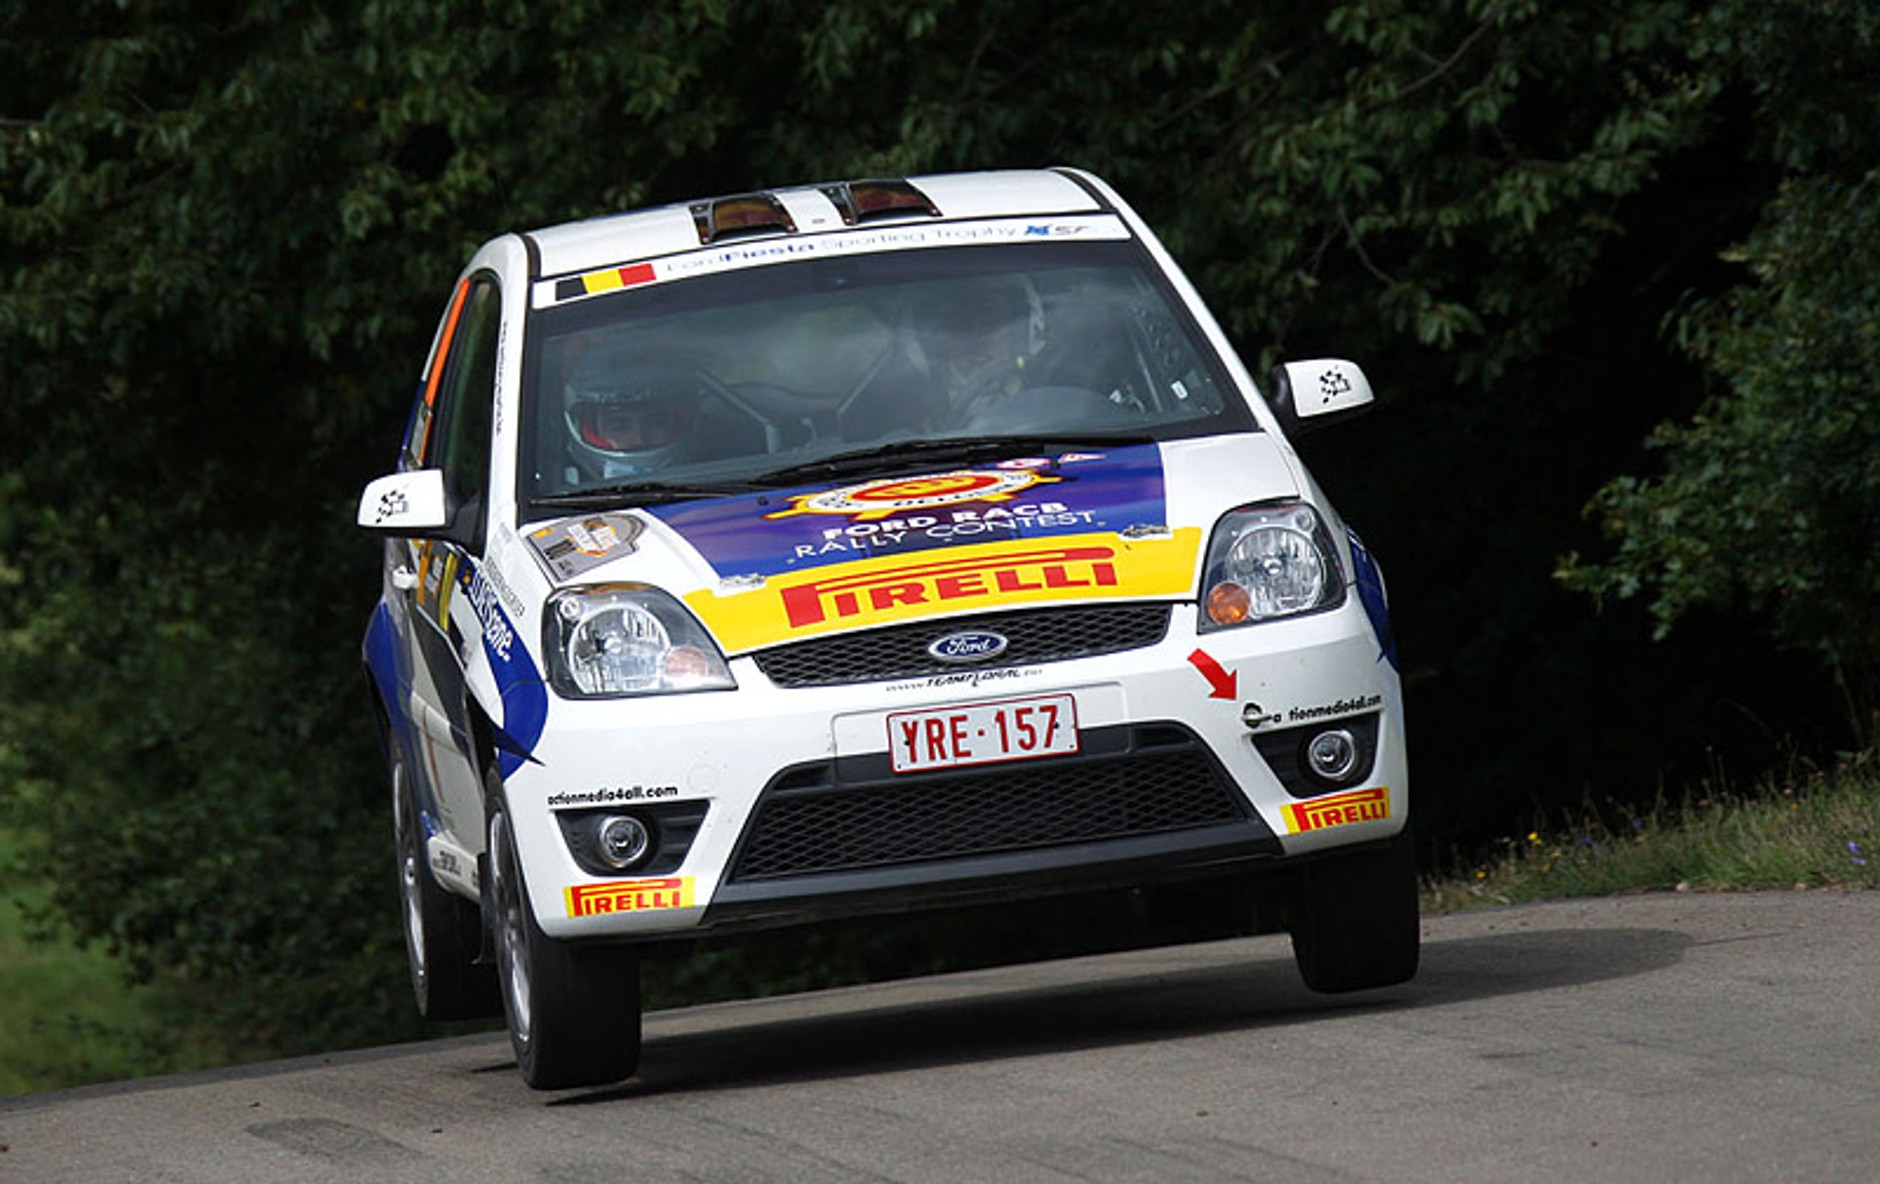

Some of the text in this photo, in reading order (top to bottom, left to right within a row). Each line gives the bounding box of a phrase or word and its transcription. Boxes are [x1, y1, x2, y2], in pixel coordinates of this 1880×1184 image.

[794, 509, 1097, 559] RALLY CONTEST
[822, 501, 1069, 541] FORD RACB
[779, 546, 1118, 630] PIRELLI
[945, 636, 992, 657] Ford
[547, 785, 679, 806] actionmedia4all.com
[1289, 787, 1389, 833] PIRELLI
[571, 877, 683, 918] PIRELLI
